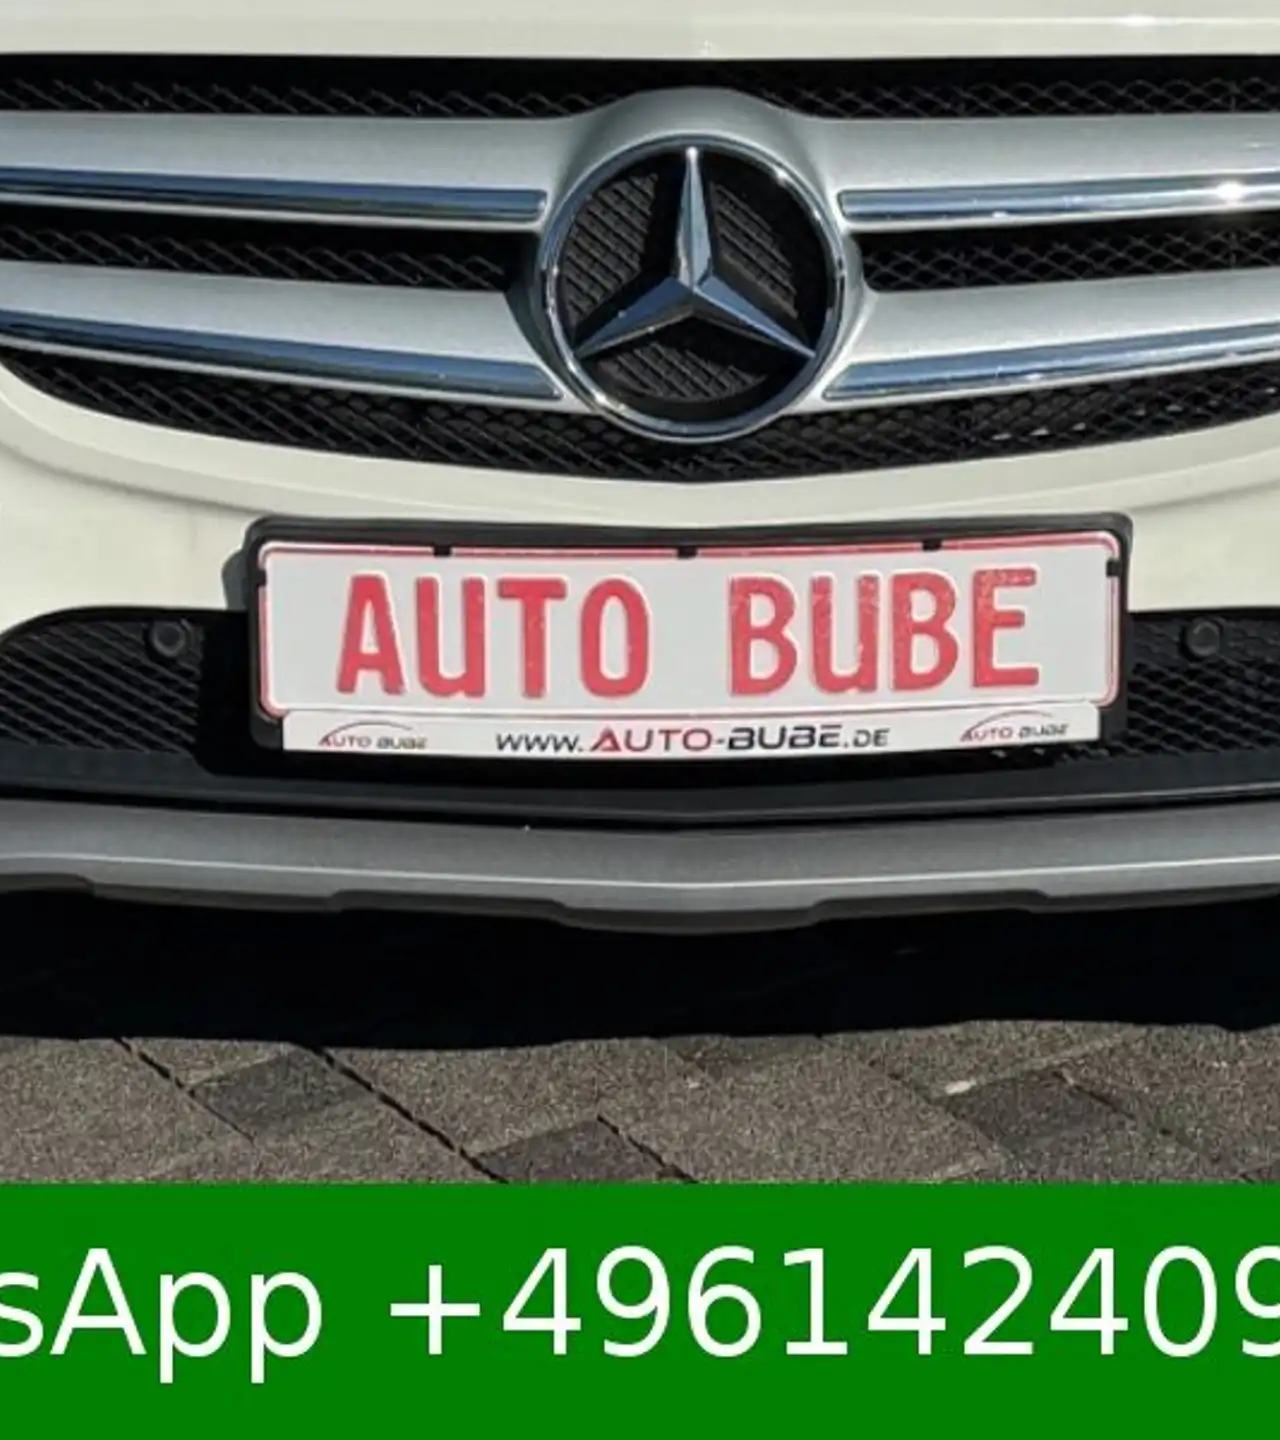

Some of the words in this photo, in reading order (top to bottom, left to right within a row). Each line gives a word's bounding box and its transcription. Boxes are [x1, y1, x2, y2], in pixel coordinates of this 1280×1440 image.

[336, 573, 651, 698] AUTO
[728, 567, 1040, 696] BUBE
[319, 734, 371, 749] AUTO
